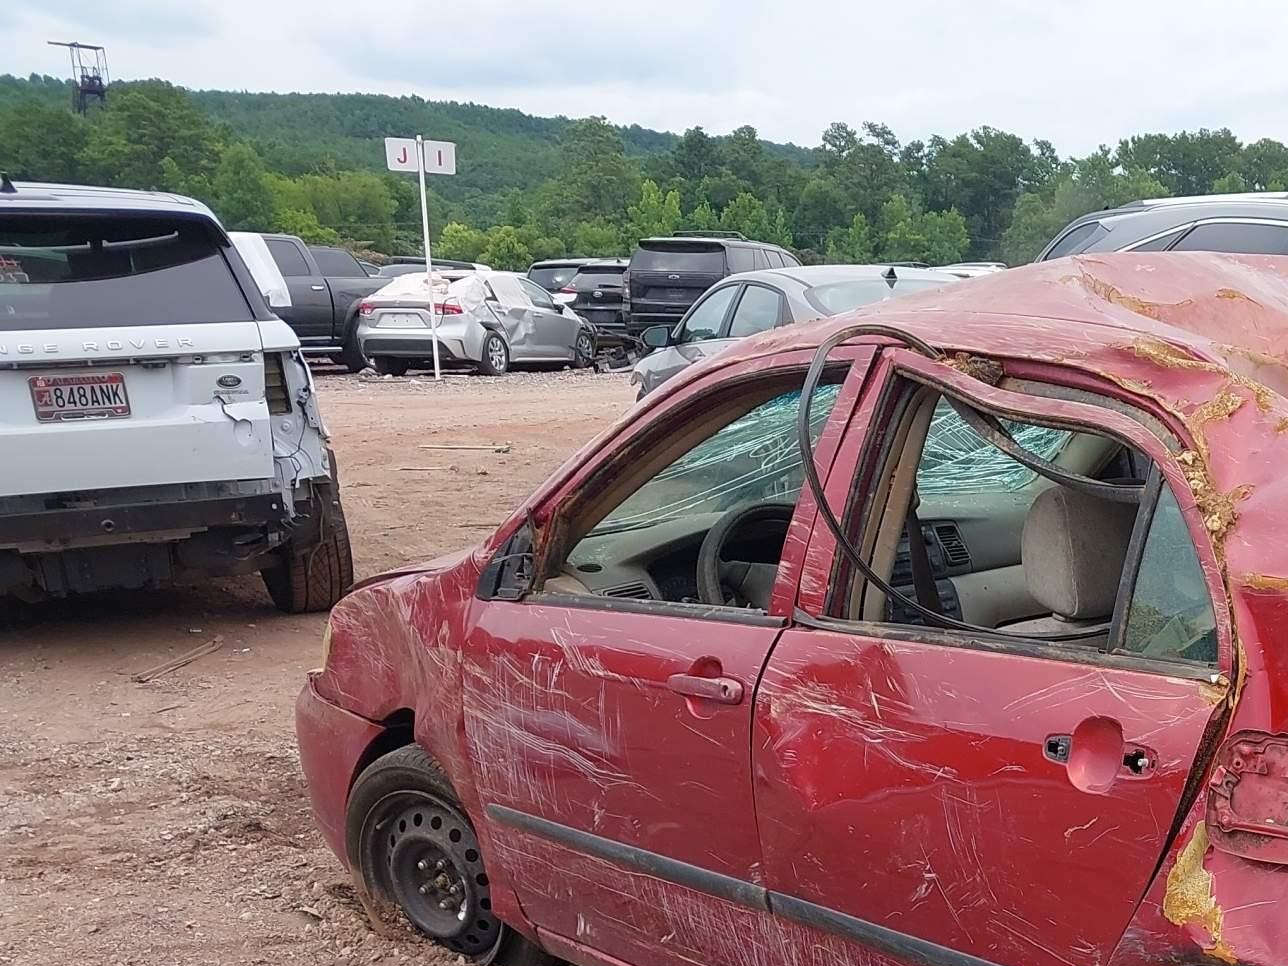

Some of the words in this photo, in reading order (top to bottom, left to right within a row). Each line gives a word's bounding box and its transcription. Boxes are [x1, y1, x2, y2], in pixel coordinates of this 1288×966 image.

[397, 147, 407, 164] J
[438, 150, 442, 166] I
[82, 337, 194, 351] ROVER
[53, 383, 124, 408] 848ANK
